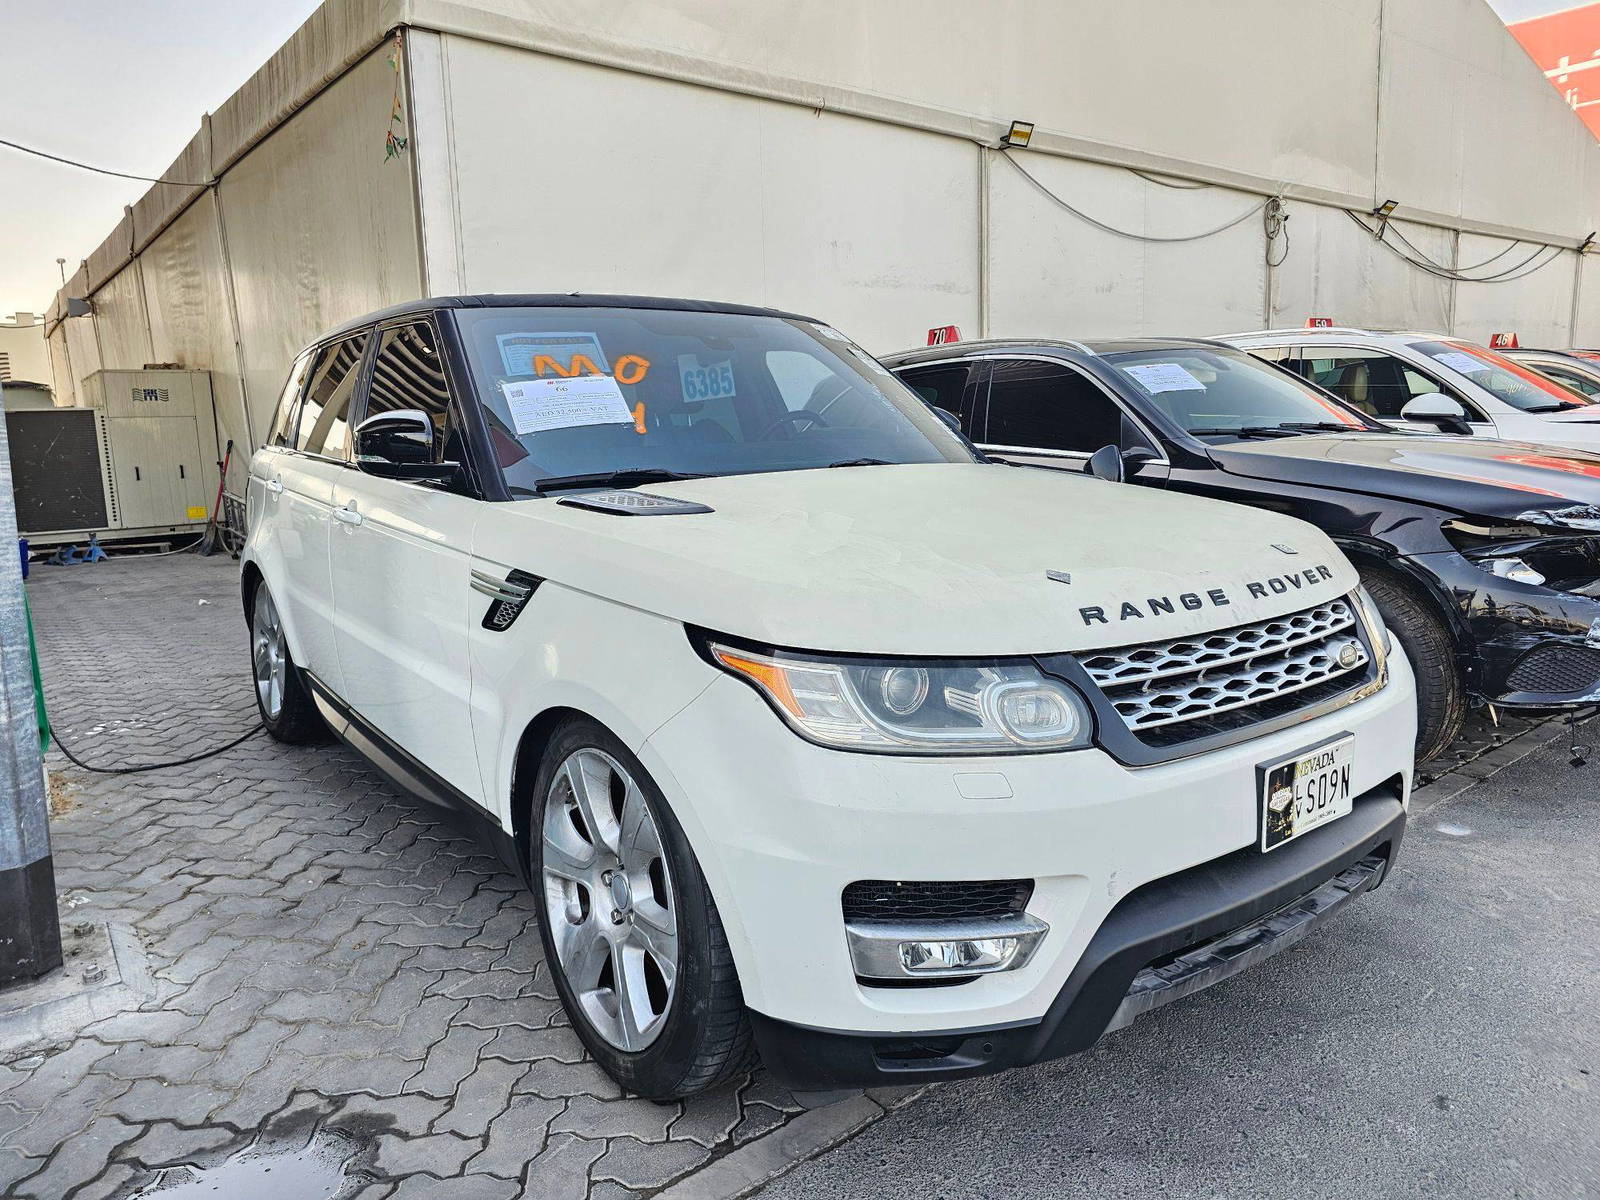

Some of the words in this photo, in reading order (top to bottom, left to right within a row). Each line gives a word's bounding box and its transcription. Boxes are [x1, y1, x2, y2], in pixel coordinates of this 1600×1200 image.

[933, 328, 946, 346] 70
[1495, 334, 1508, 346] 46
[683, 366, 733, 400] 6385
[1078, 588, 1231, 626] RANGE
[1246, 564, 1334, 600] ROVER
[1295, 750, 1335, 779] NEVADA
